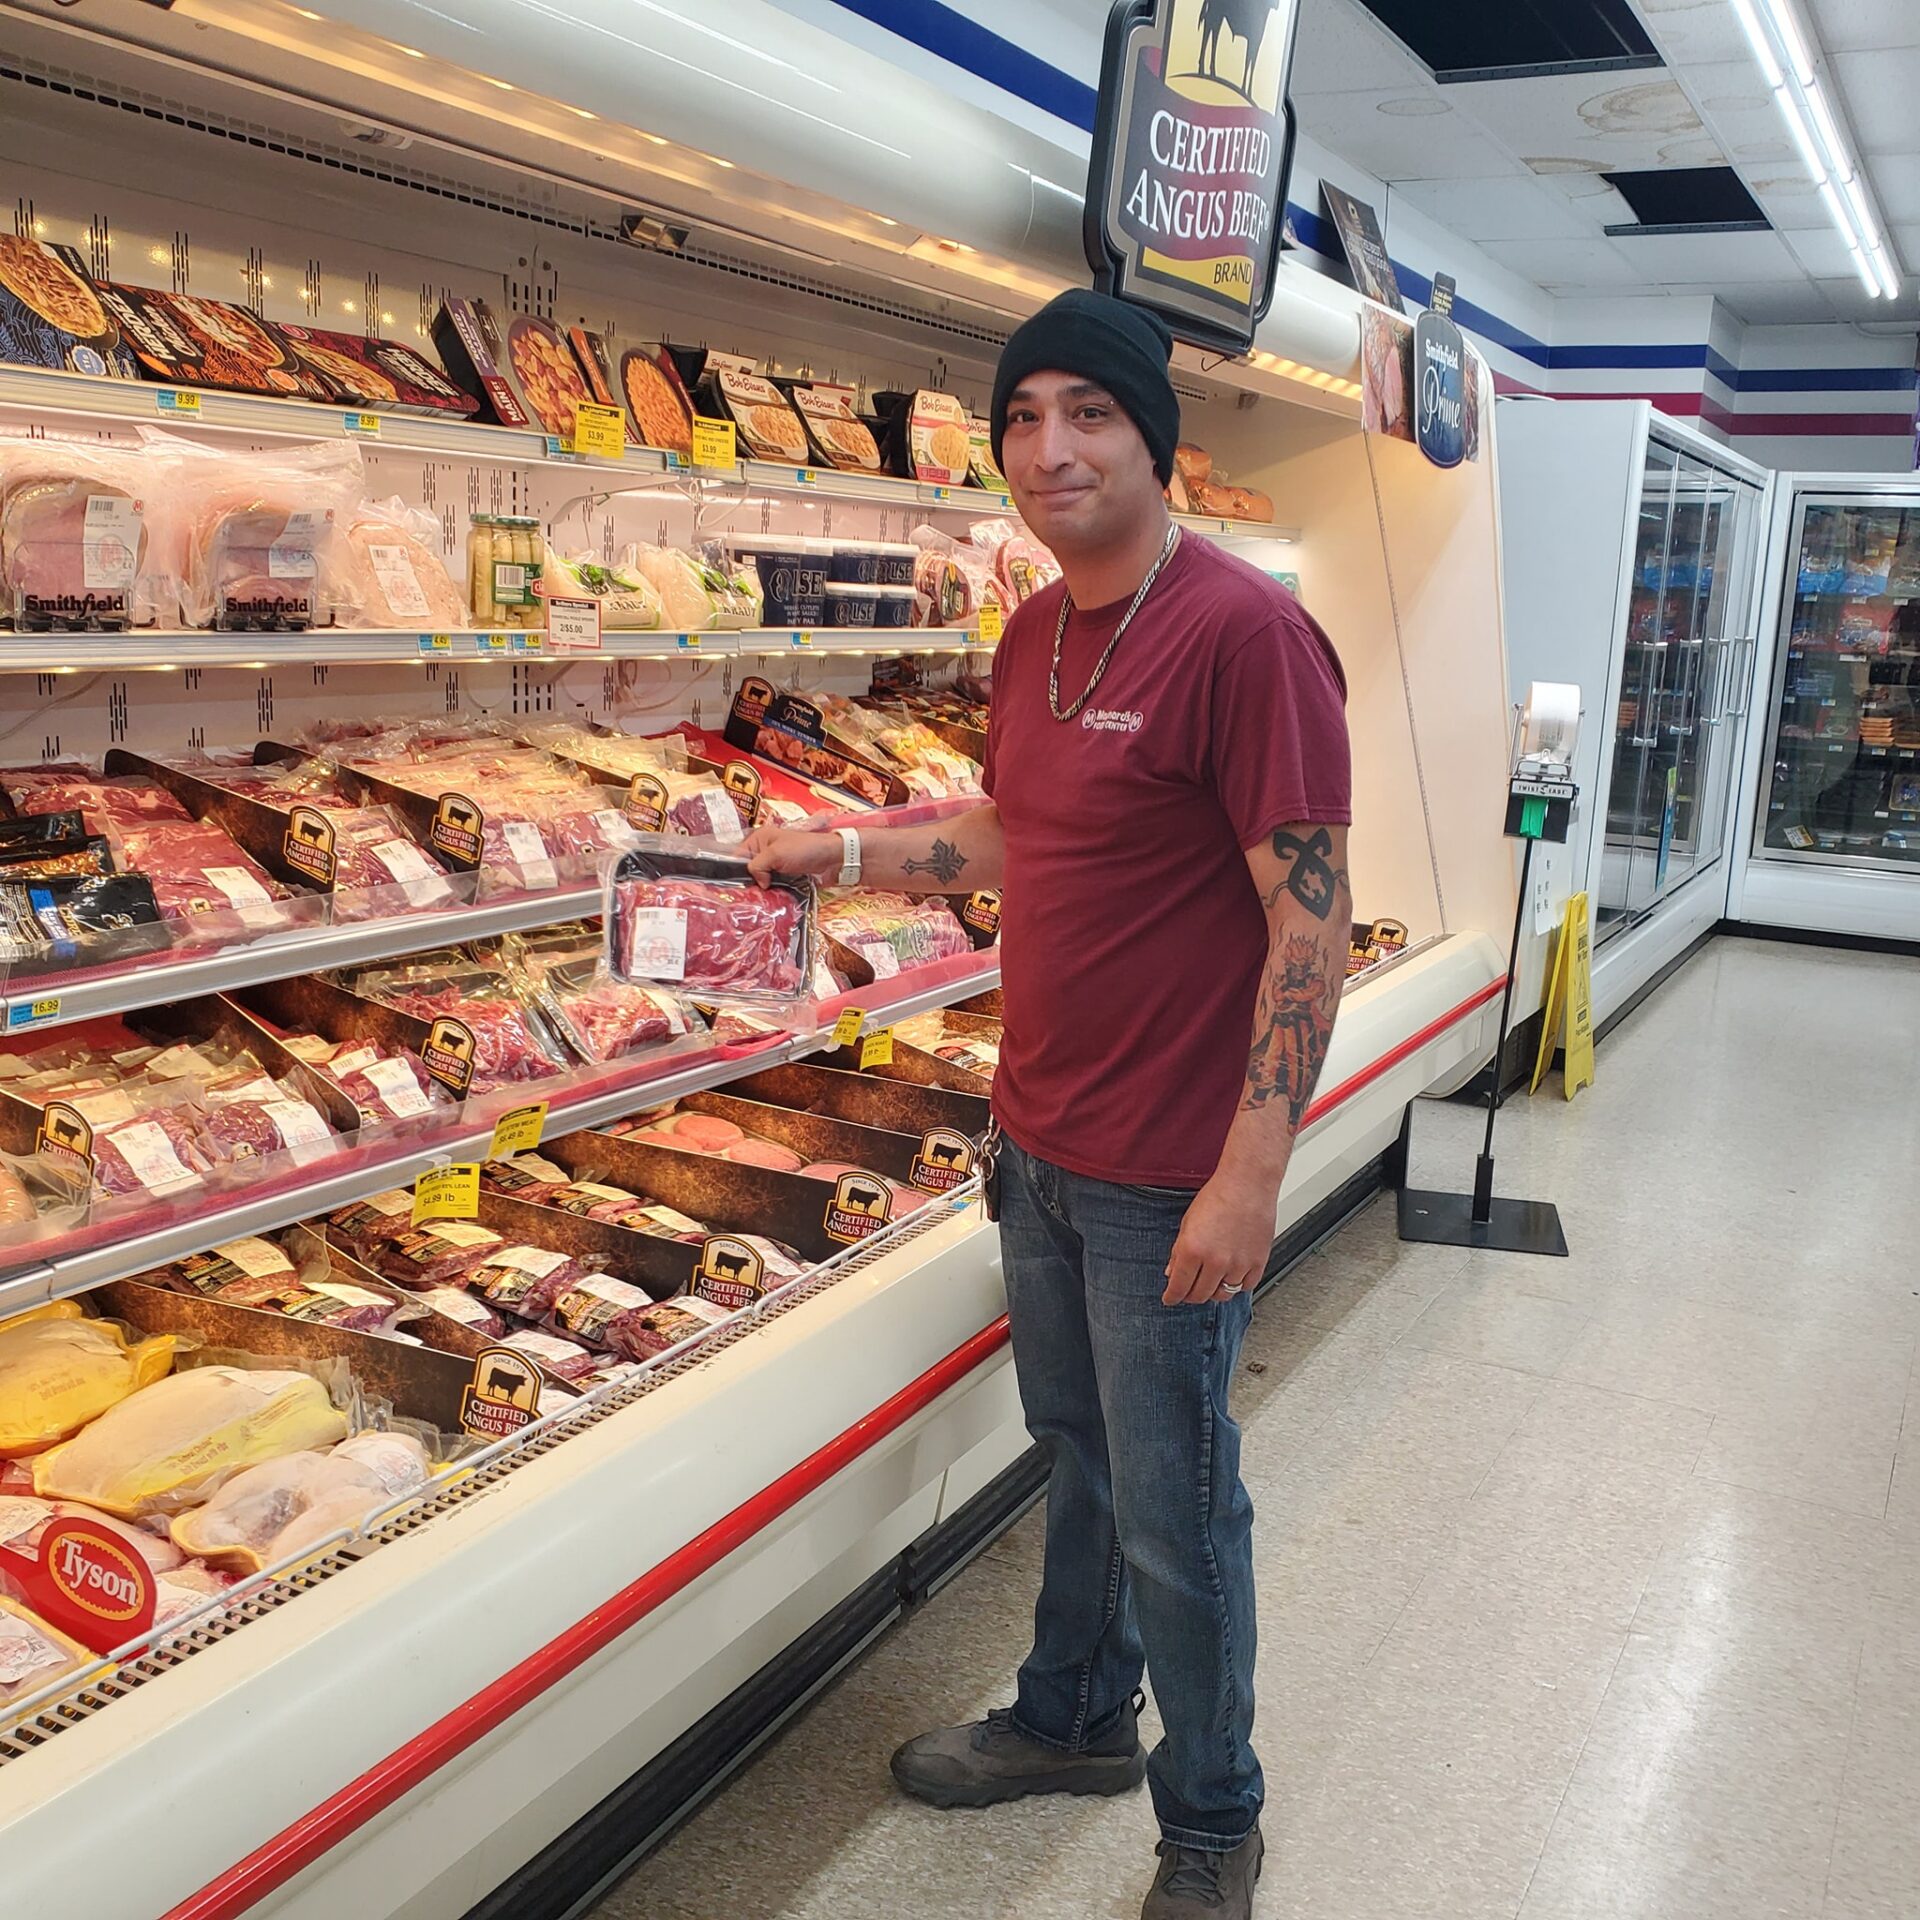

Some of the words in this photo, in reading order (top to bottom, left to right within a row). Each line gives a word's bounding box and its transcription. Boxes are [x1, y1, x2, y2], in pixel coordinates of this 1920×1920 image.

[1150, 109, 1271, 179] CERTIFIED
[1126, 168, 1227, 239] ANGUS
[1213, 262, 1253, 285] BRAND
[101, 291, 177, 362] HERDEZ
[454, 313, 481, 361] ROASTED
[1425, 338, 1459, 372] Smithfield
[386, 349, 456, 397] HERDEZ
[490, 381, 502, 390] ST
[725, 373, 743, 388] Bob
[742, 377, 766, 393] Evans
[178, 394, 196, 405] 9.99
[498, 391, 521, 422] MAIN
[798, 391, 816, 406] Bob
[814, 395, 837, 410] Evans
[920, 395, 934, 410] Bob
[934, 398, 953, 413] Evans
[1422, 365, 1461, 434] Prime
[360, 416, 375, 426] 9.99
[587, 430, 604, 441] $3.99
[25, 593, 125, 618] Smithfield
[226, 596, 309, 618] Smithfield
[723, 606, 757, 618] KRAUT
[789, 700, 814, 715] Smithfield
[780, 707, 812, 728] Prime
[434, 830, 459, 846] ANGUS
[437, 824, 475, 843] CERTIFIED
[287, 847, 312, 864] ANGUS
[290, 840, 328, 861] CERTIFIED
[34, 1000, 59, 1014] 16.99
[424, 1055, 449, 1072] ANGUS
[428, 1049, 465, 1069] CERTIFIED
[913, 1172, 944, 1187] ANGUS
[918, 1164, 965, 1182] CERTIFIED
[445, 1194, 455, 1202] lb
[828, 1219, 860, 1236] ANGUS
[861, 1228, 877, 1237] BE
[833, 1210, 882, 1229] CERTIFIED
[695, 1286, 731, 1305] ANGUS
[700, 1277, 754, 1298] CERTIFIED
[493, 1356, 511, 1365] SINCE
[471, 1399, 529, 1425] CERTIFIED
[464, 1410, 503, 1433] ANGUS
[505, 1422, 521, 1435] BE
[61, 1537, 137, 1607] Tyson
